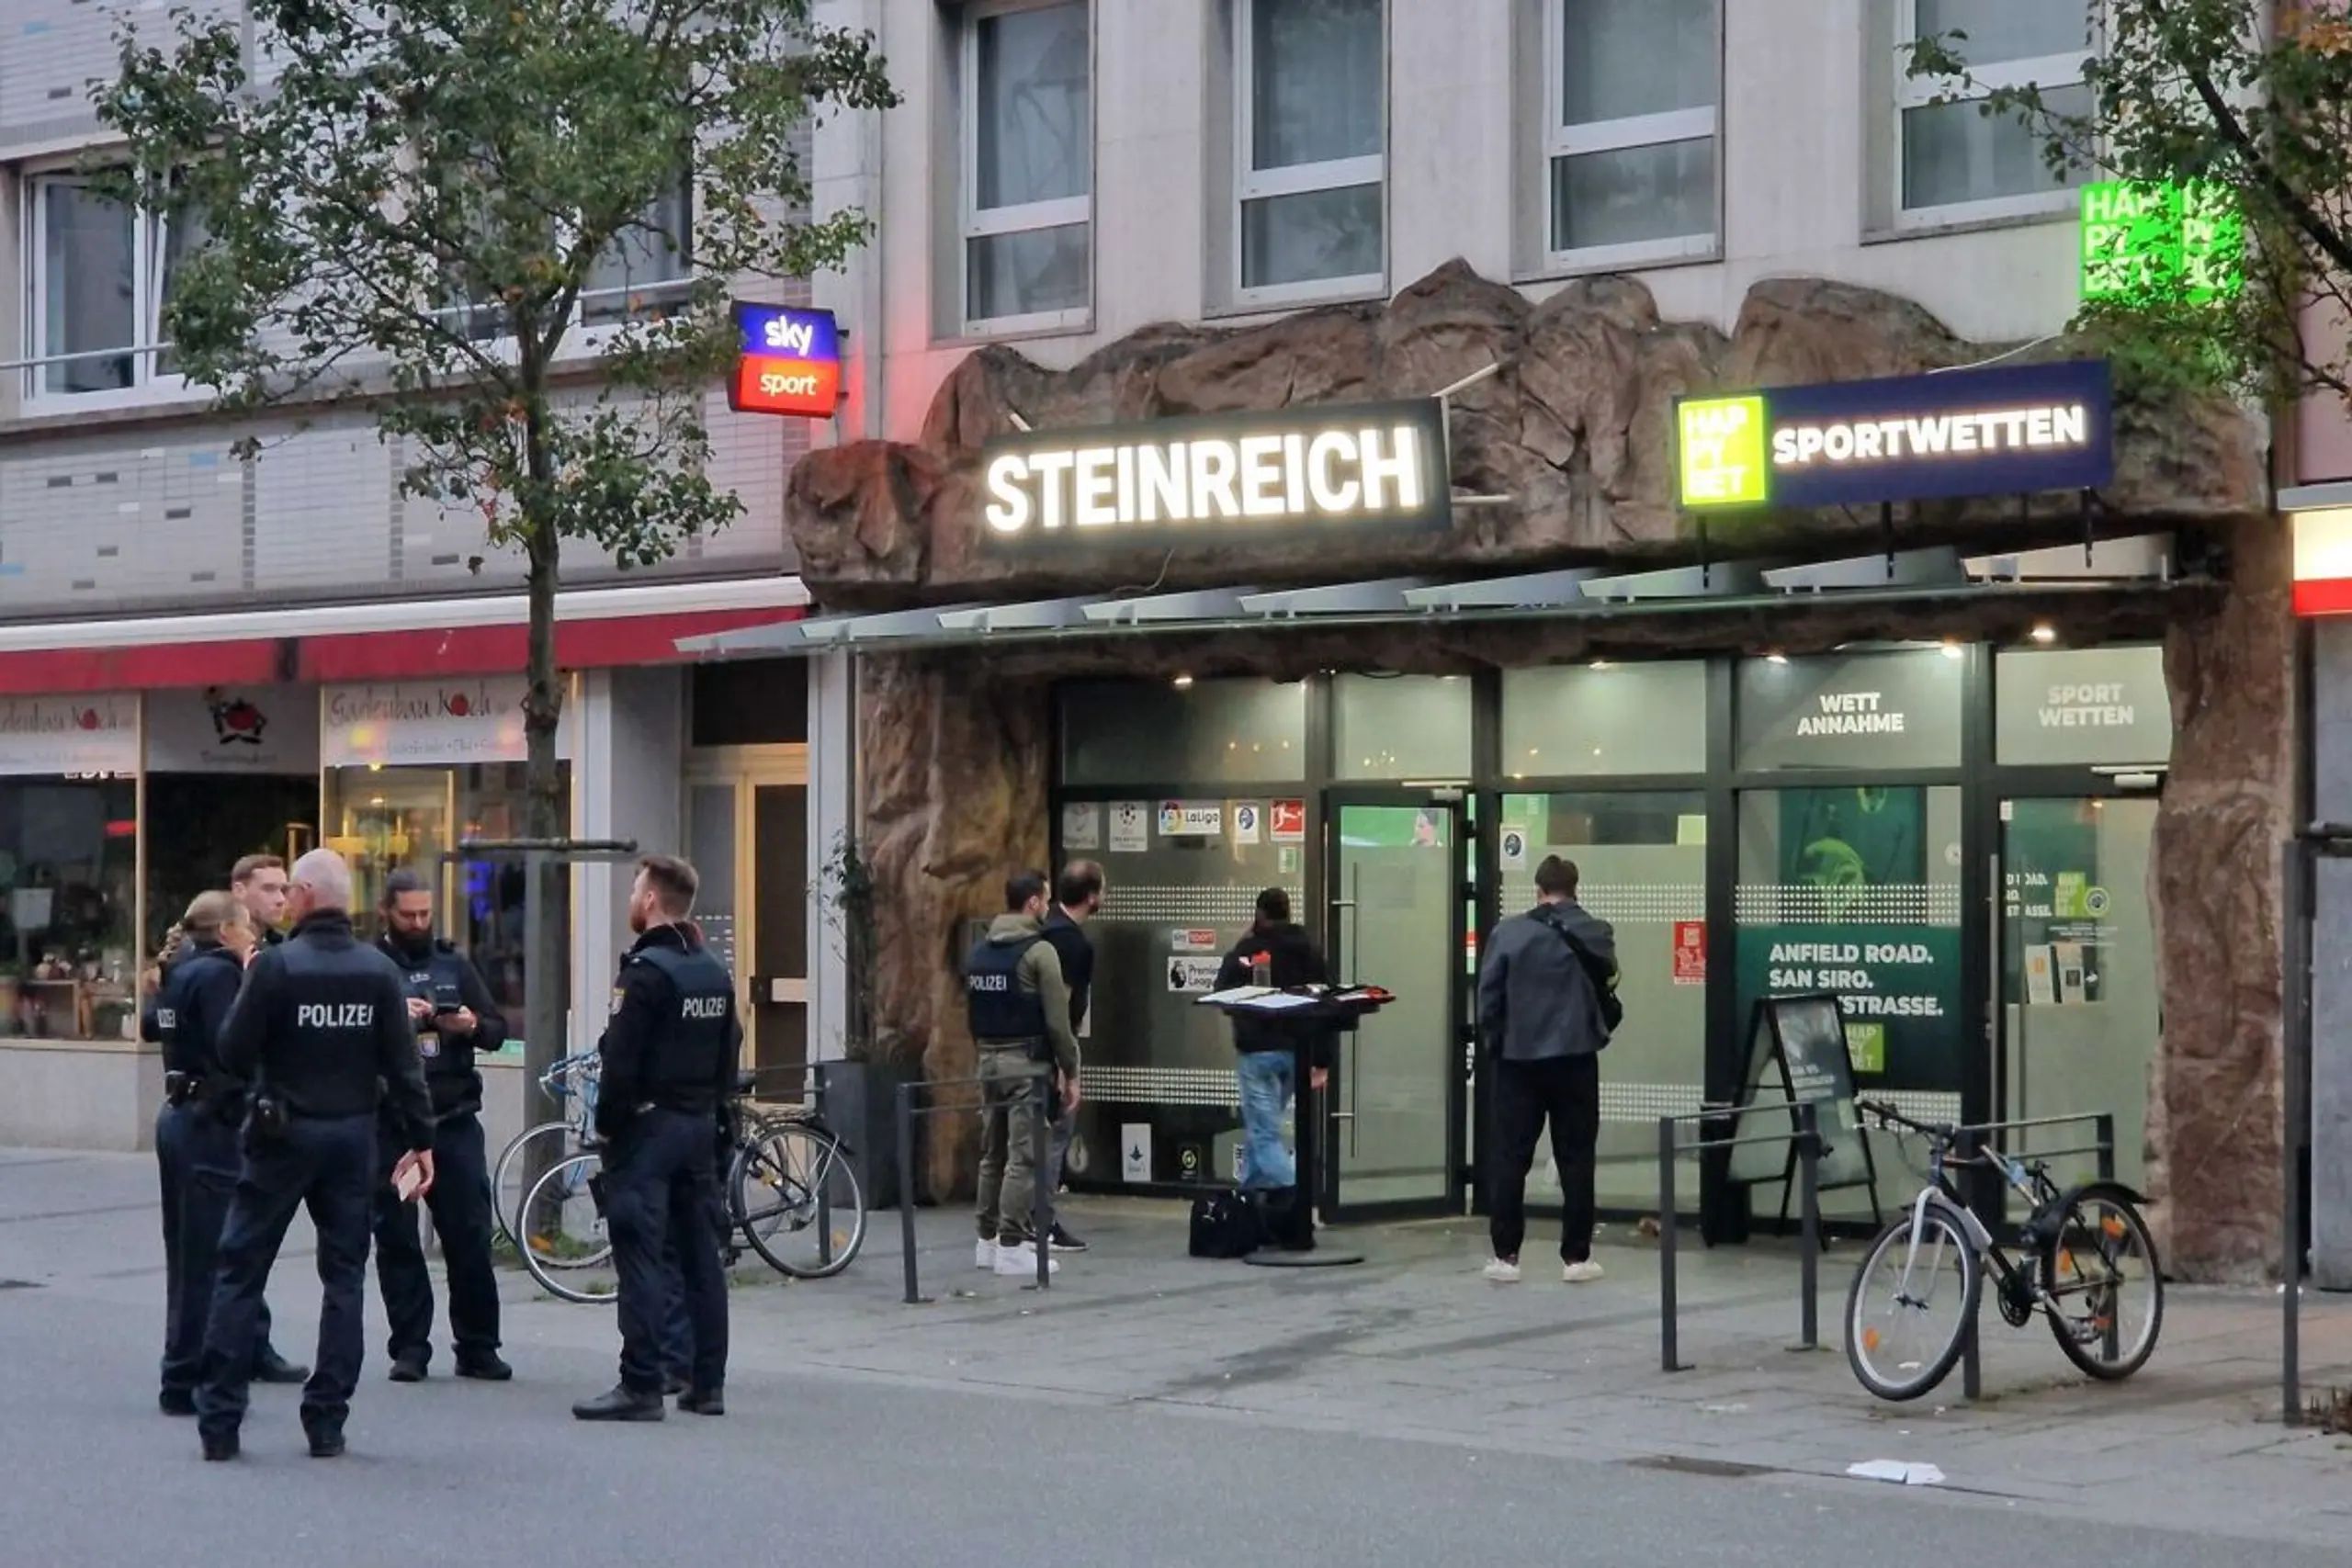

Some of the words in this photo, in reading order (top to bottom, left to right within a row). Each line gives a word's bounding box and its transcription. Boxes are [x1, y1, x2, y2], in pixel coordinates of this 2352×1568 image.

[764, 315, 813, 356] sky
[760, 373, 817, 397] sport
[1773, 405, 2086, 465] SPORTWETTEN
[986, 427, 1423, 532] STEINREICH
[1820, 692, 1881, 713] WETT
[2048, 683, 2123, 706] SPORT
[1797, 713, 1905, 736] ANNAHME
[2039, 705, 2134, 728] WETTEN
[1769, 944, 1859, 963] ANFIELD
[1865, 944, 1934, 964] ROAD.
[1770, 970, 1812, 987] SAN
[1818, 970, 1874, 988] SIRO.
[298, 1005, 374, 1027] POLIZEI
[682, 998, 726, 1018] POLIZEI
